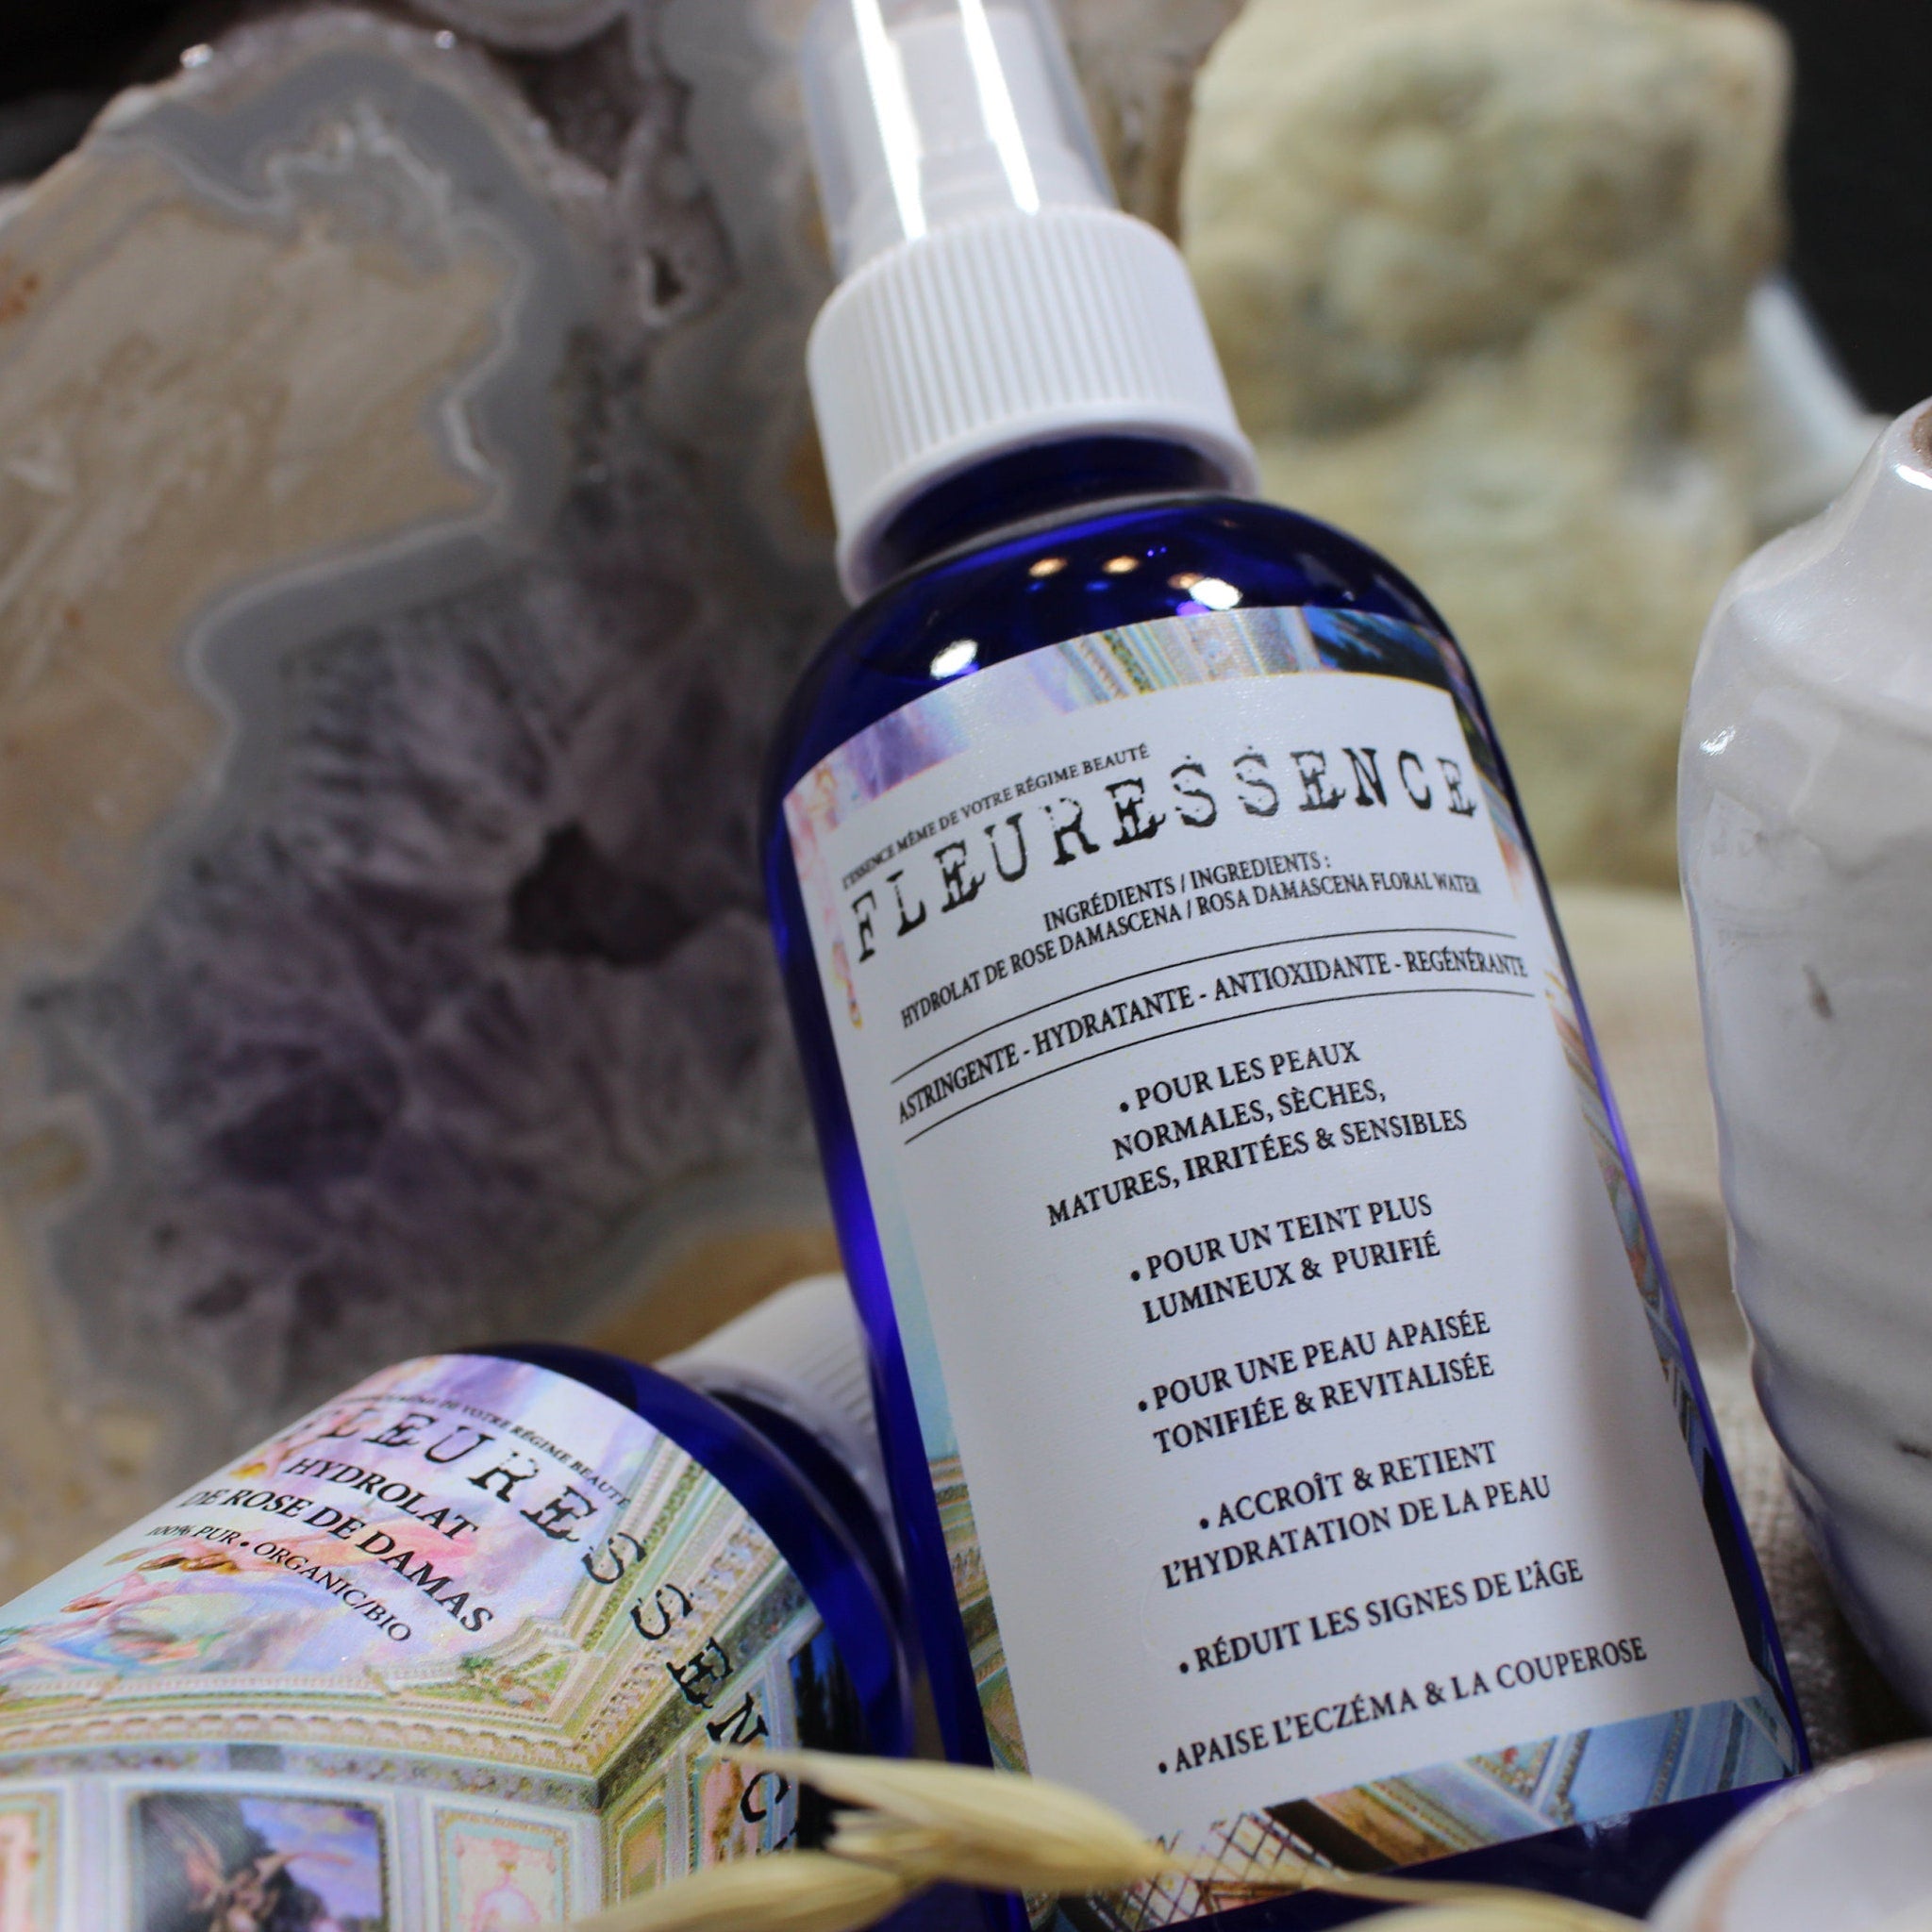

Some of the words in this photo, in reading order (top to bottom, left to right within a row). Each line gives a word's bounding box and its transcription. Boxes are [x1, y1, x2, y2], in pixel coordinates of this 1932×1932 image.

[896, 821, 936, 854] MÊME
[940, 812, 959, 831] DE
[960, 787, 1013, 818] VOTRE
[1014, 764, 1080, 797] RÉGIME
[1082, 742, 1150, 775] BEAUTÉ
[851, 746, 1477, 962] FLEURESSENCE
[1043, 876, 1175, 932] INGRÉDIENTS
[900, 970, 981, 1028] HYDROLAT
[984, 959, 1008, 986] DE
[1009, 939, 1058, 974] ROSE
[1058, 904, 1182, 956] DAMASCENA
[1196, 890, 1251, 916] ROSA
[1252, 874, 1369, 906] DAMASCENA
[1370, 871, 1434, 892] FLORAL
[1433, 873, 1481, 895] WATER
[899, 1042, 1020, 1124] ASTRINGENTE
[1032, 985, 1195, 1056] HYDRATANTE
[1214, 952, 1392, 1002] ANTIOXIDANTE
[1135, 1070, 1213, 1110] POUR
[1218, 1058, 1265, 1089] LES
[1270, 1041, 1361, 1076] PEAUX
[1046, 1165, 1180, 1227] MATURES,
[1183, 1131, 1310, 1182] IRRITÉES
[1316, 1126, 1335, 1151] &
[1341, 1108, 1468, 1145] SENSIBLES
[1112, 1099, 1274, 1160] NORMALES,
[1277, 1078, 1387, 1117] SÈCHES,
[1142, 1262, 1297, 1324] LUMINEUX
[1302, 1257, 1323, 1280] &
[1332, 1229, 1441, 1274] PURIFIÉ
[1146, 1238, 1226, 1280] POUR
[1229, 1225, 1273, 1255] UN
[1275, 1205, 1362, 1243] TEINT
[1367, 1193, 1434, 1224] PLUS
[1152, 1368, 1232, 1410] POUR
[1235, 1349, 1298, 1385] UNE
[1303, 1331, 1377, 1368] PEAU
[1386, 1308, 1492, 1352] APAISÉE
[1153, 1396, 1289, 1454] TONIFIÉE
[1295, 1391, 1317, 1415] &
[1320, 1352, 1495, 1409] REVITALISÉE
[284, 1457, 478, 1540] HYDROLAT
[509, 1424, 570, 1463] RÉGIME
[569, 1459, 631, 1507] BEAUTÉ
[1217, 1472, 1343, 1528] ACCROÎT
[1354, 1467, 1374, 1491] &
[1378, 1440, 1498, 1486] RETIENT
[1398, 1496, 1439, 1526] DE
[1441, 1488, 1480, 1517] LA
[1486, 1474, 1552, 1508] PEAU
[175, 1489, 230, 1508] DE
[218, 1489, 309, 1519] ROSE
[304, 1506, 365, 1540] DE
[355, 1529, 494, 1632] DAMAS
[190, 1525, 242, 1545] PUR
[253, 1541, 412, 1643] ORGANIC/BIO
[1193, 1622, 1302, 1674] RÉDUIT
[1310, 1607, 1360, 1641] LES
[1366, 1581, 1468, 1627] SIGNES
[1473, 1572, 1511, 1603] DE
[1174, 1725, 1270, 1774] APAISE
[1425, 1681, 1447, 1706] &
[1451, 1672, 1491, 1701] LA
[1495, 1637, 1648, 1689] COUPEROSE
